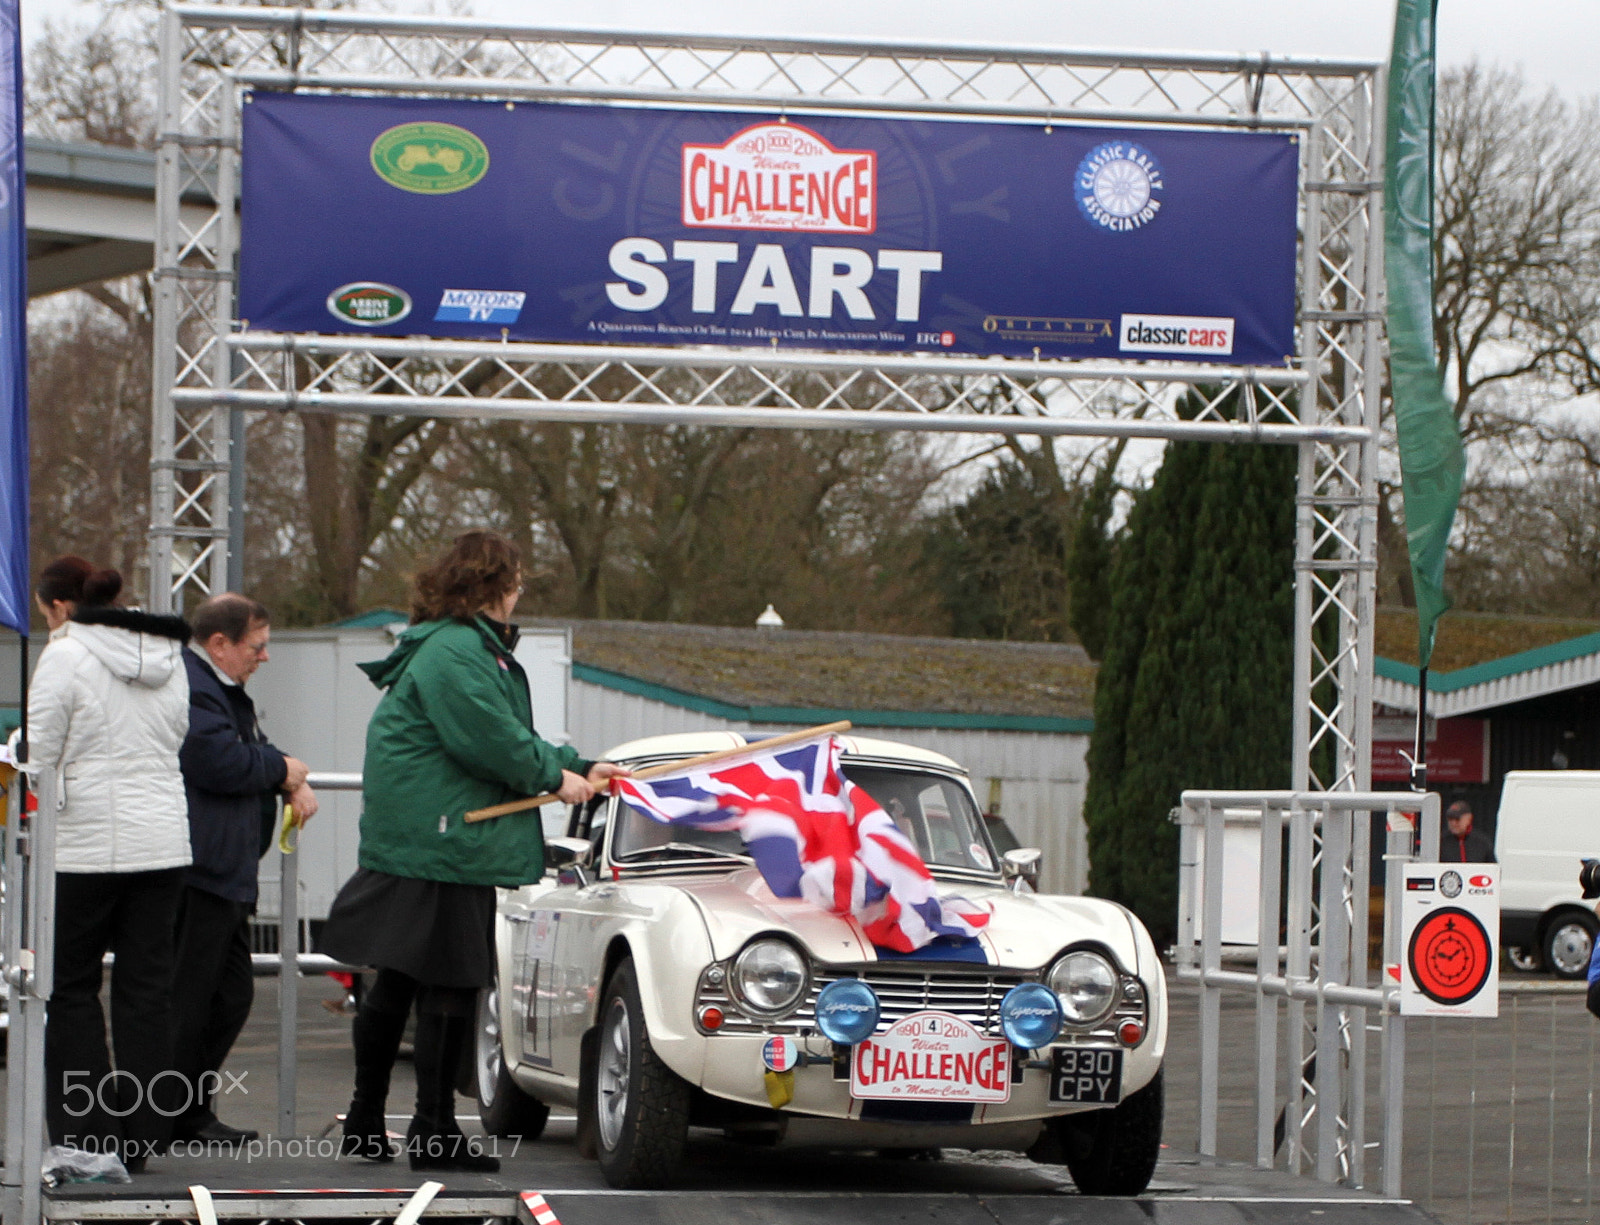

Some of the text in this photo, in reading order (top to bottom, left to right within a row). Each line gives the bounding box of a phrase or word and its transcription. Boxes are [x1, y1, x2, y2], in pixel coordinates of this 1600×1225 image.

[752, 155, 800, 170] Winter
[1081, 145, 1163, 190] CLASSIC RALLY
[690, 152, 869, 228] CHALLENGE
[1083, 196, 1161, 231] ASSOCIATION
[605, 237, 943, 322] START
[445, 290, 523, 308] MOTORS
[469, 306, 494, 321] TV
[916, 332, 941, 345] EFG
[897, 1019, 968, 1038] 1990 4 2014
[911, 1038, 950, 1051] Winter
[857, 1040, 1006, 1092] CHALLENGE
[1060, 1050, 1114, 1074] 330
[891, 1084, 901, 1094] to
[906, 1083, 970, 1097] Monte-Carlo
[1058, 1077, 1114, 1101] CPY
